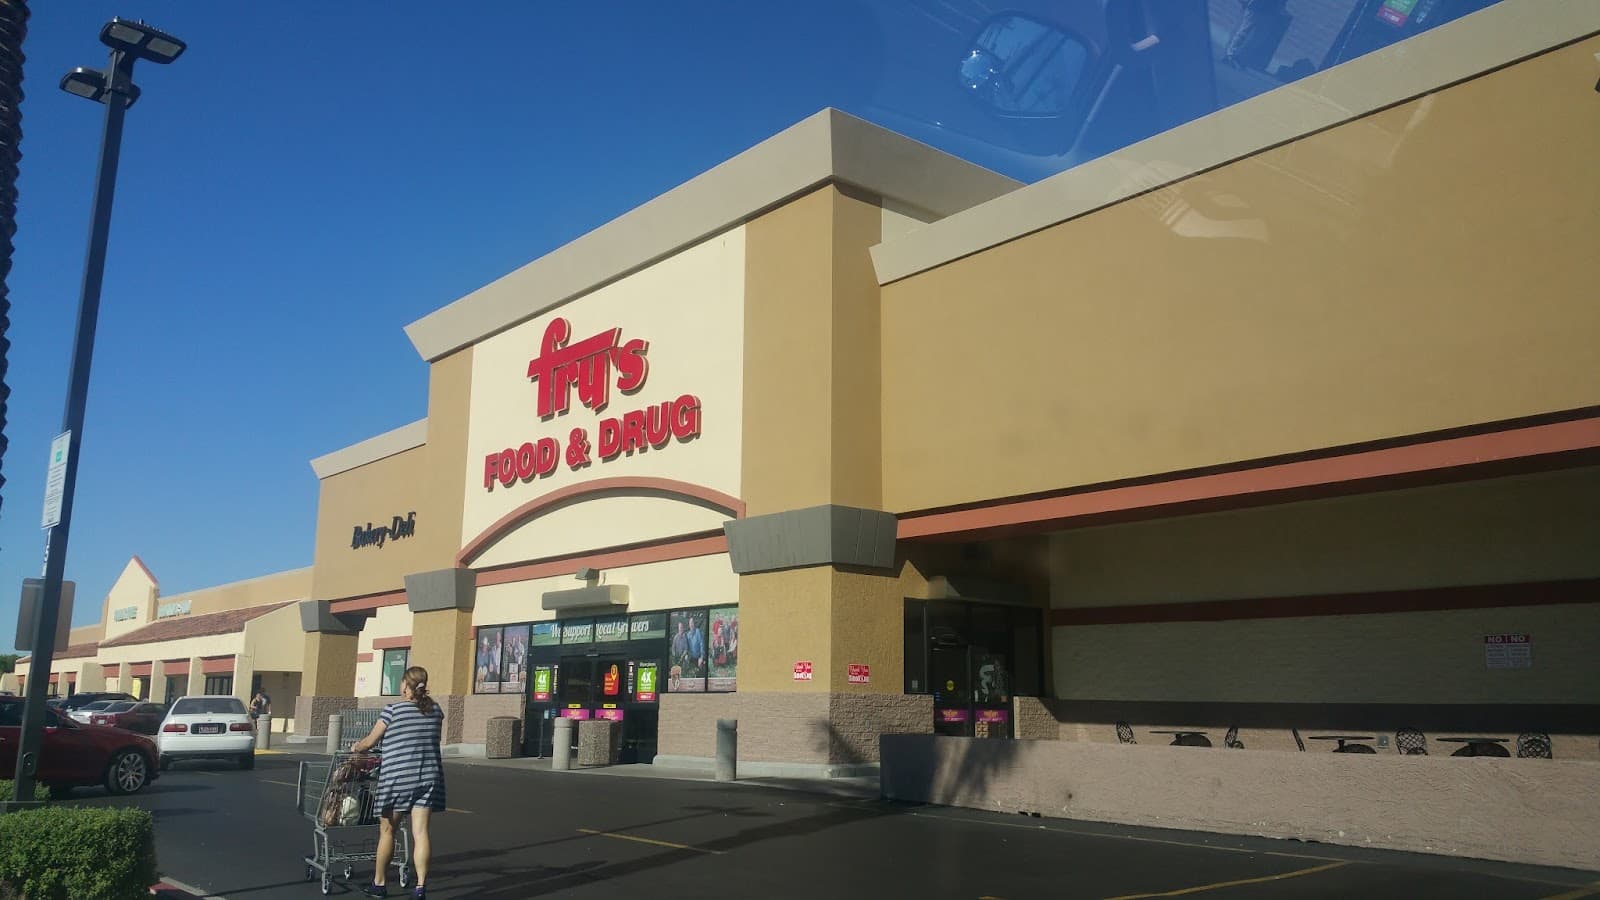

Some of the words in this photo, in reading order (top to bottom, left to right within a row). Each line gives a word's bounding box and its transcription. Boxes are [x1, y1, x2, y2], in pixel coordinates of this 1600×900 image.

[527, 317, 649, 420] fry's
[484, 437, 558, 491] FOOD
[565, 427, 591, 470] &
[598, 394, 701, 463] DRUG
[617, 619, 649, 638] Grwers
